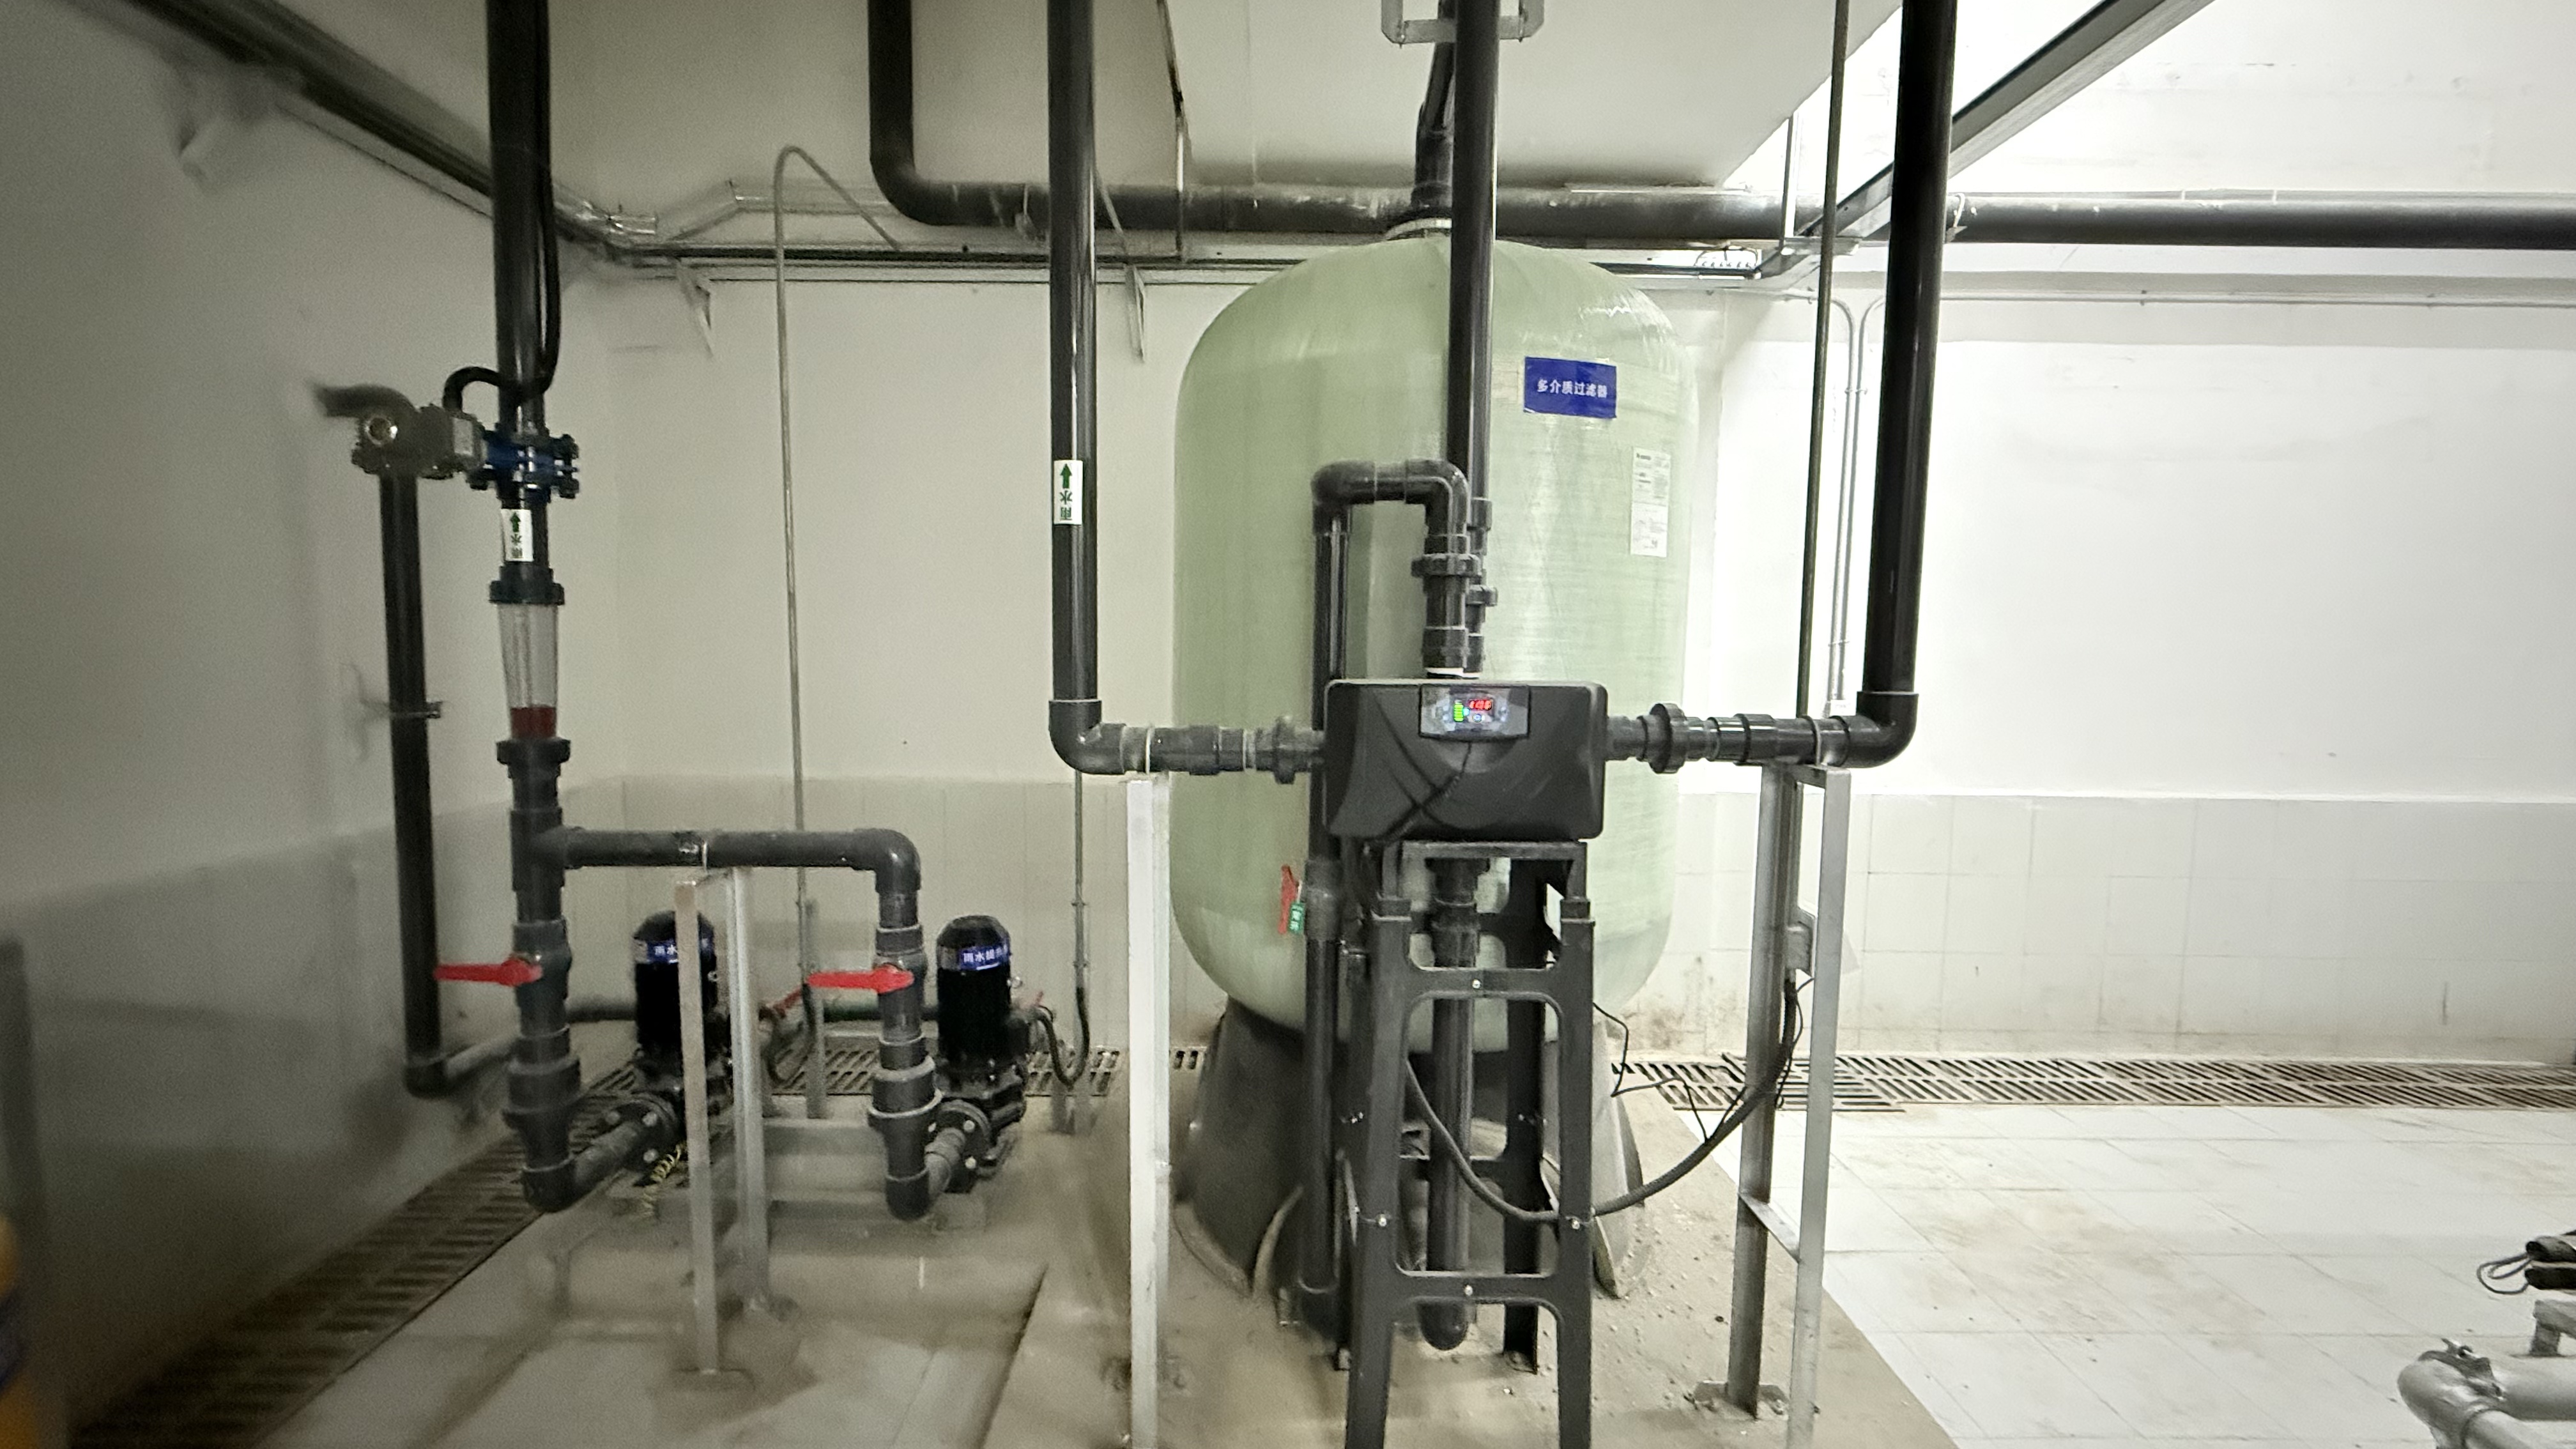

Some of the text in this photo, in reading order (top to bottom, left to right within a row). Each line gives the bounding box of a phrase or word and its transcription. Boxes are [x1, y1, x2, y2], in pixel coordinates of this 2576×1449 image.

[1537, 378, 1607, 398] 多介质过滤器
[1060, 490, 1073, 521] 雨水
